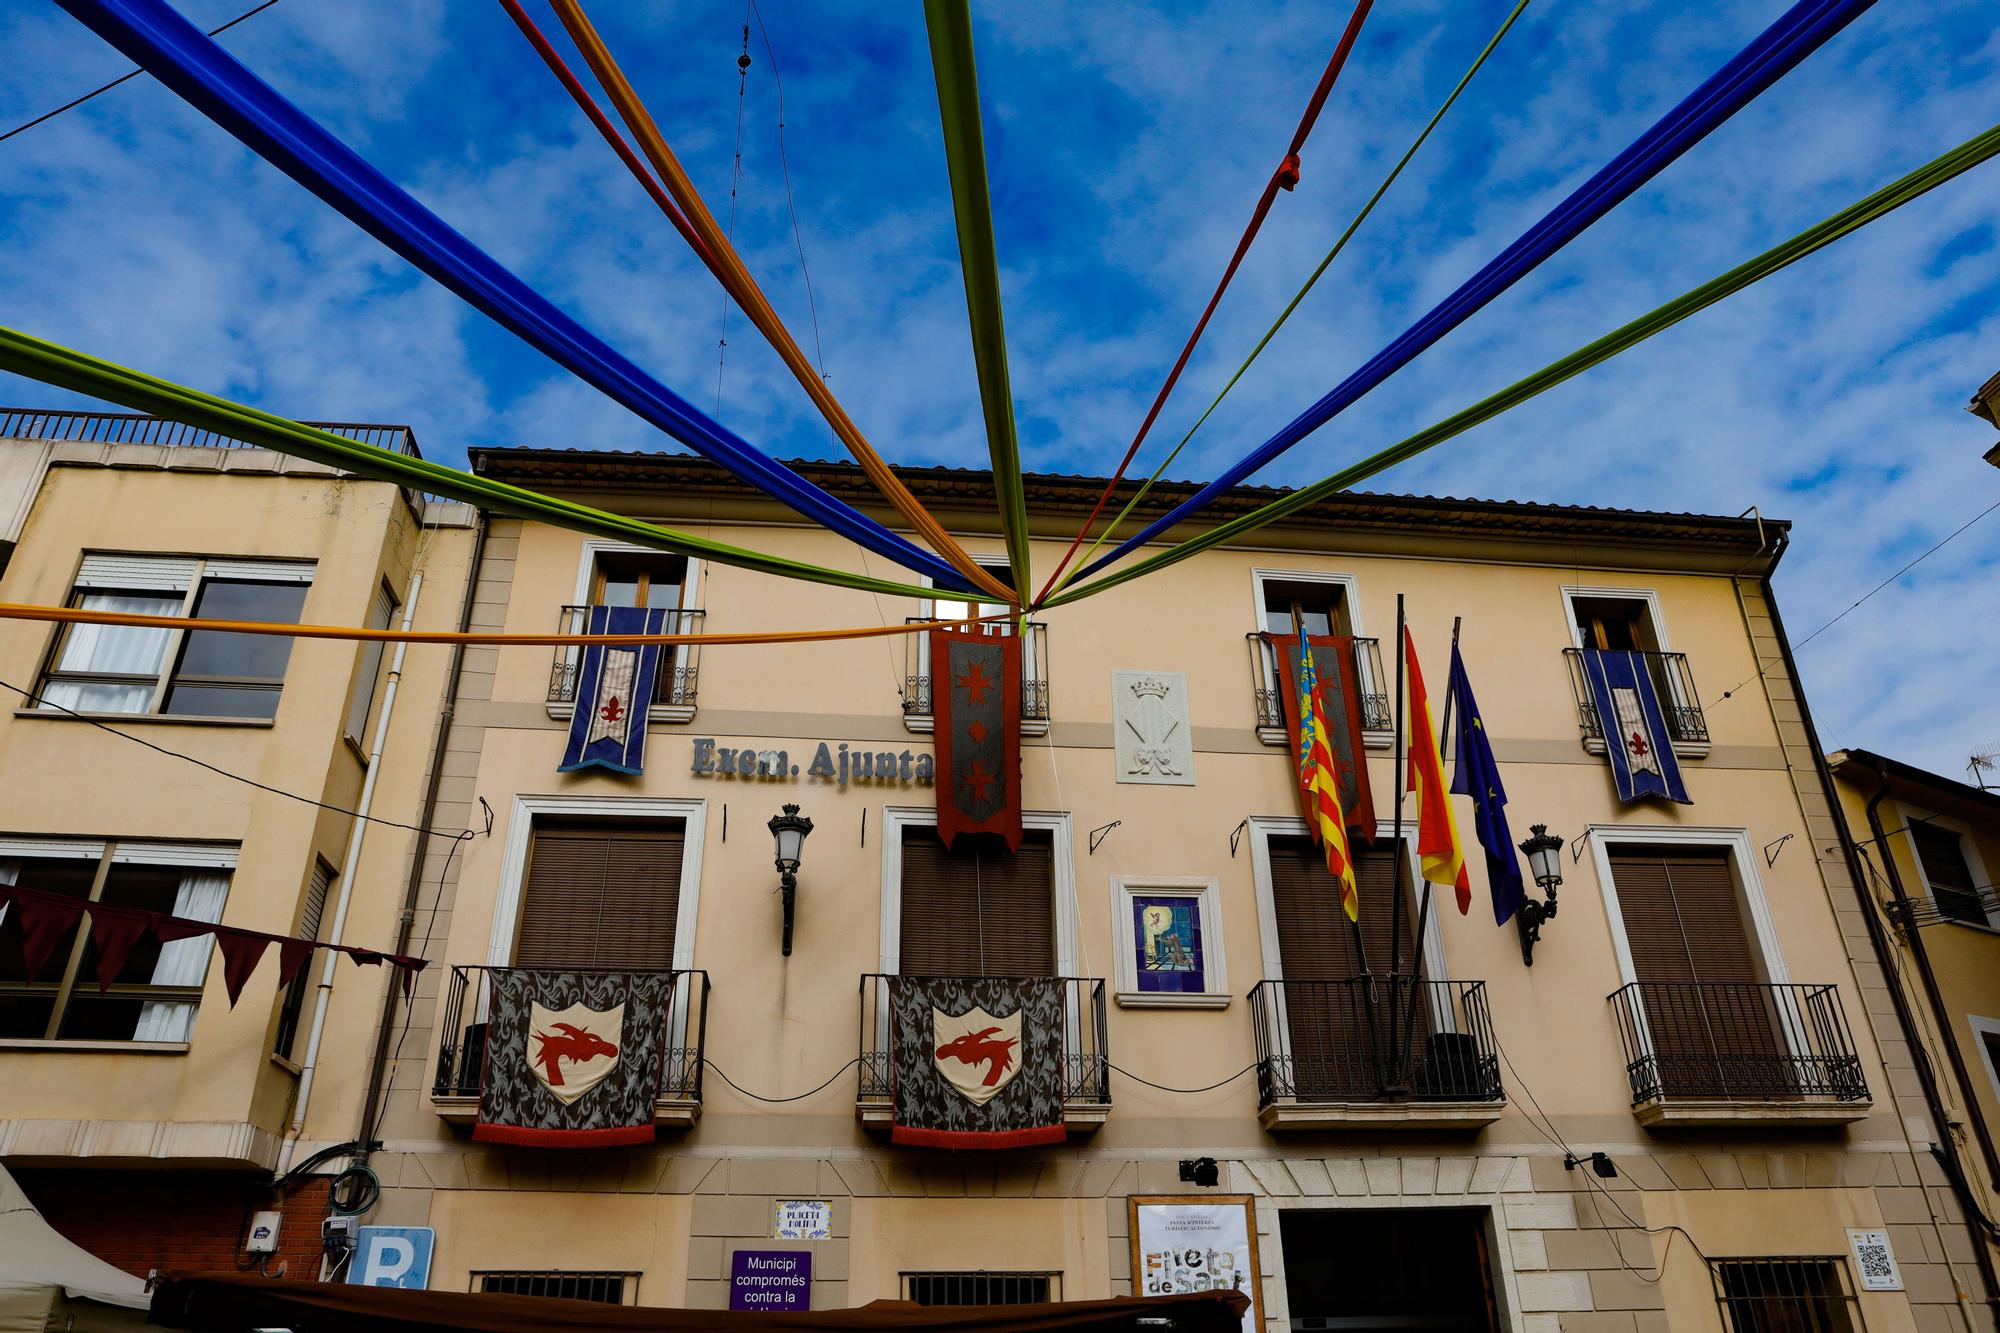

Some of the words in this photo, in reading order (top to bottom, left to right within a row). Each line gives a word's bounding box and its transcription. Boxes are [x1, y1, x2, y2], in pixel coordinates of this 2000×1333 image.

[690, 738, 800, 776] Excm.
[748, 1257, 796, 1273] Municipi
[736, 1274, 806, 1289] compromés
[1148, 1276, 1173, 1294] de
[744, 1291, 782, 1303] contra
[785, 1290, 796, 1303] la
